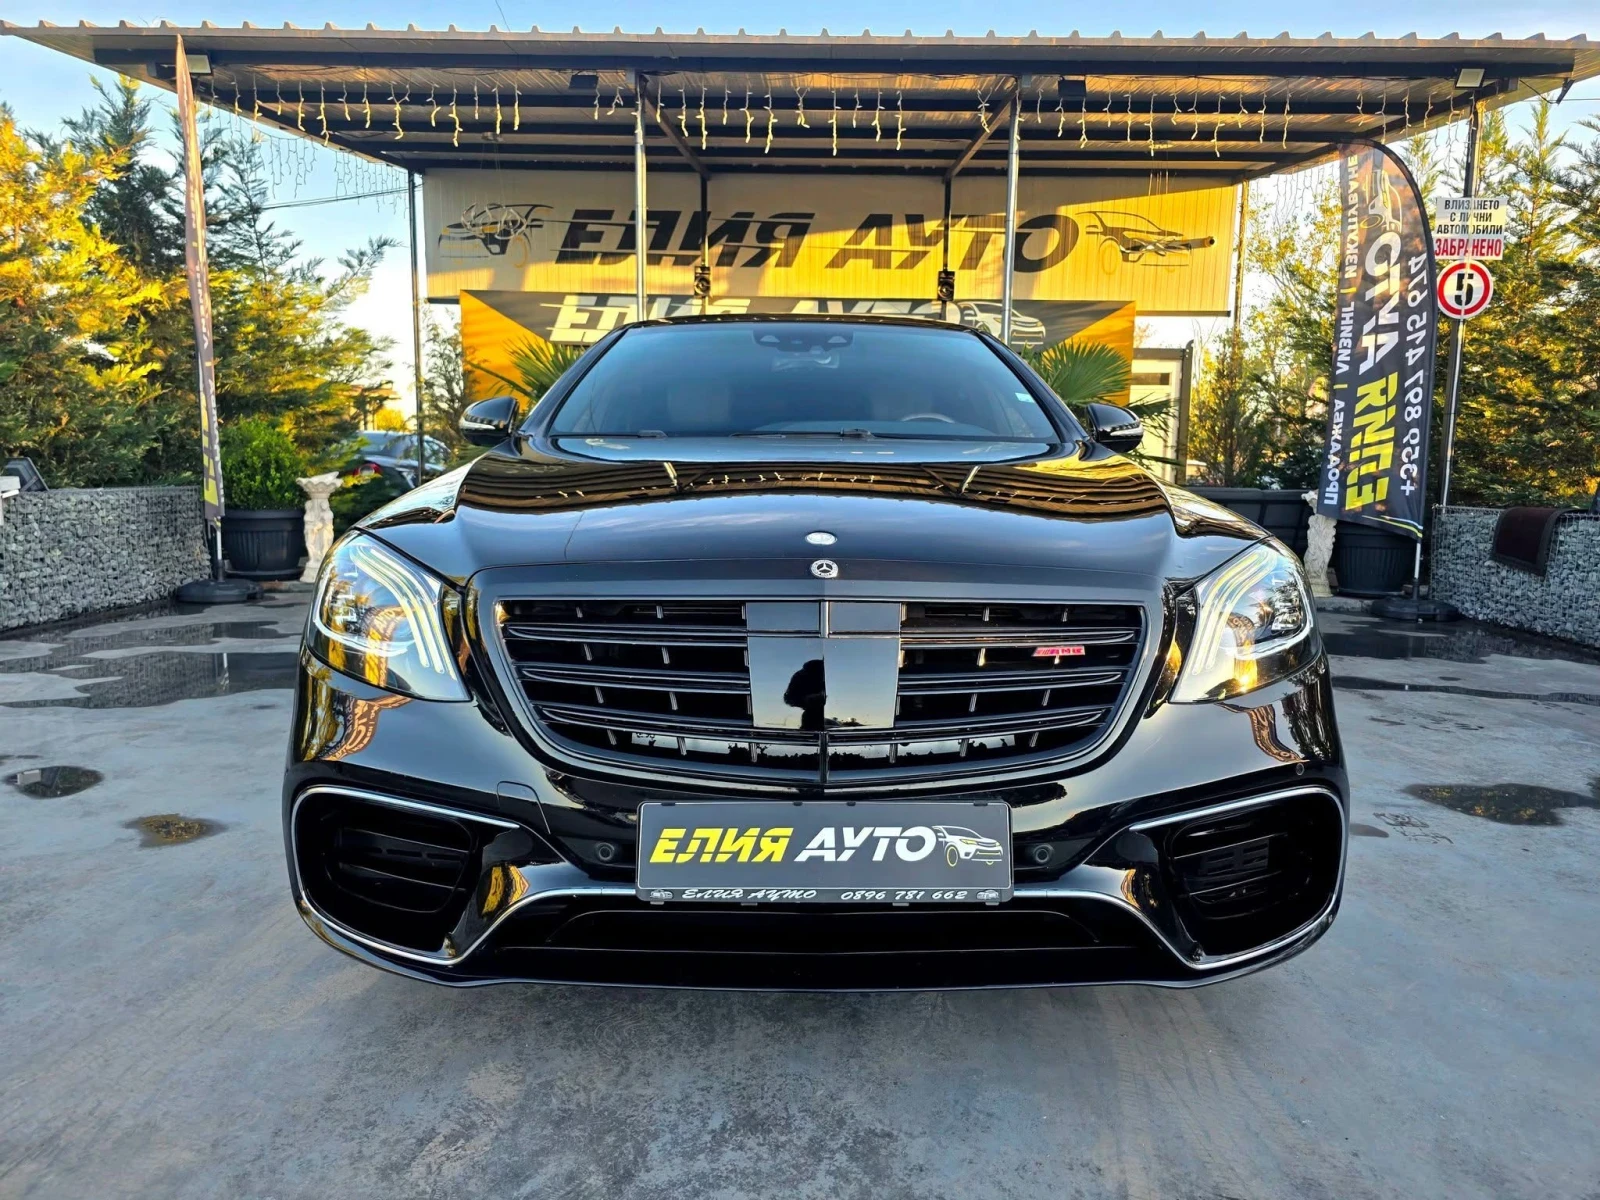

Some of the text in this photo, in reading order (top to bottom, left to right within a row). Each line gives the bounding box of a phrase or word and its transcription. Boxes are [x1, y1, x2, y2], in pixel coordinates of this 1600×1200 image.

[1449, 212, 1456, 222] С
[554, 208, 1080, 274] ЕЛИЯ АУТО
[1454, 273, 1474, 306] 5
[649, 826, 937, 864] ЕЛИЯ АУТО
[840, 890, 887, 900] 0896
[895, 890, 925, 900] 781
[931, 890, 968, 900] 662
